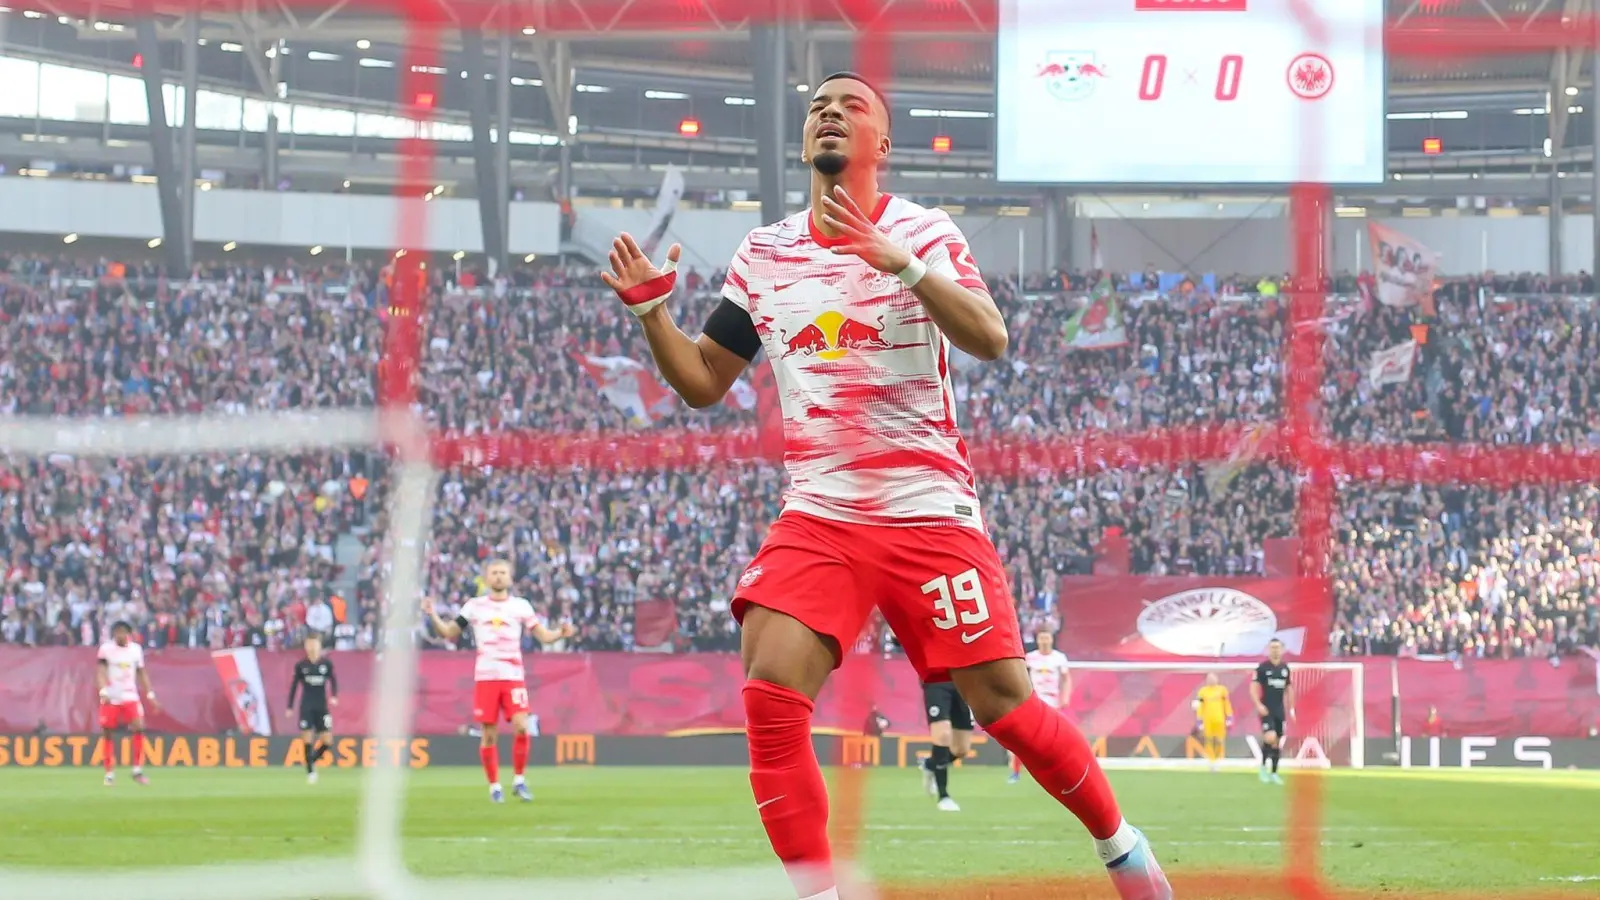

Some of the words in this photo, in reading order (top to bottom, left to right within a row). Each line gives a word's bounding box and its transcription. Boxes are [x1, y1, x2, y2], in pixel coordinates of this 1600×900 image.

[1139, 55, 1167, 101] 0
[1215, 55, 1243, 101] 0
[920, 567, 990, 630] 39
[284, 737, 430, 768] ASSETS
